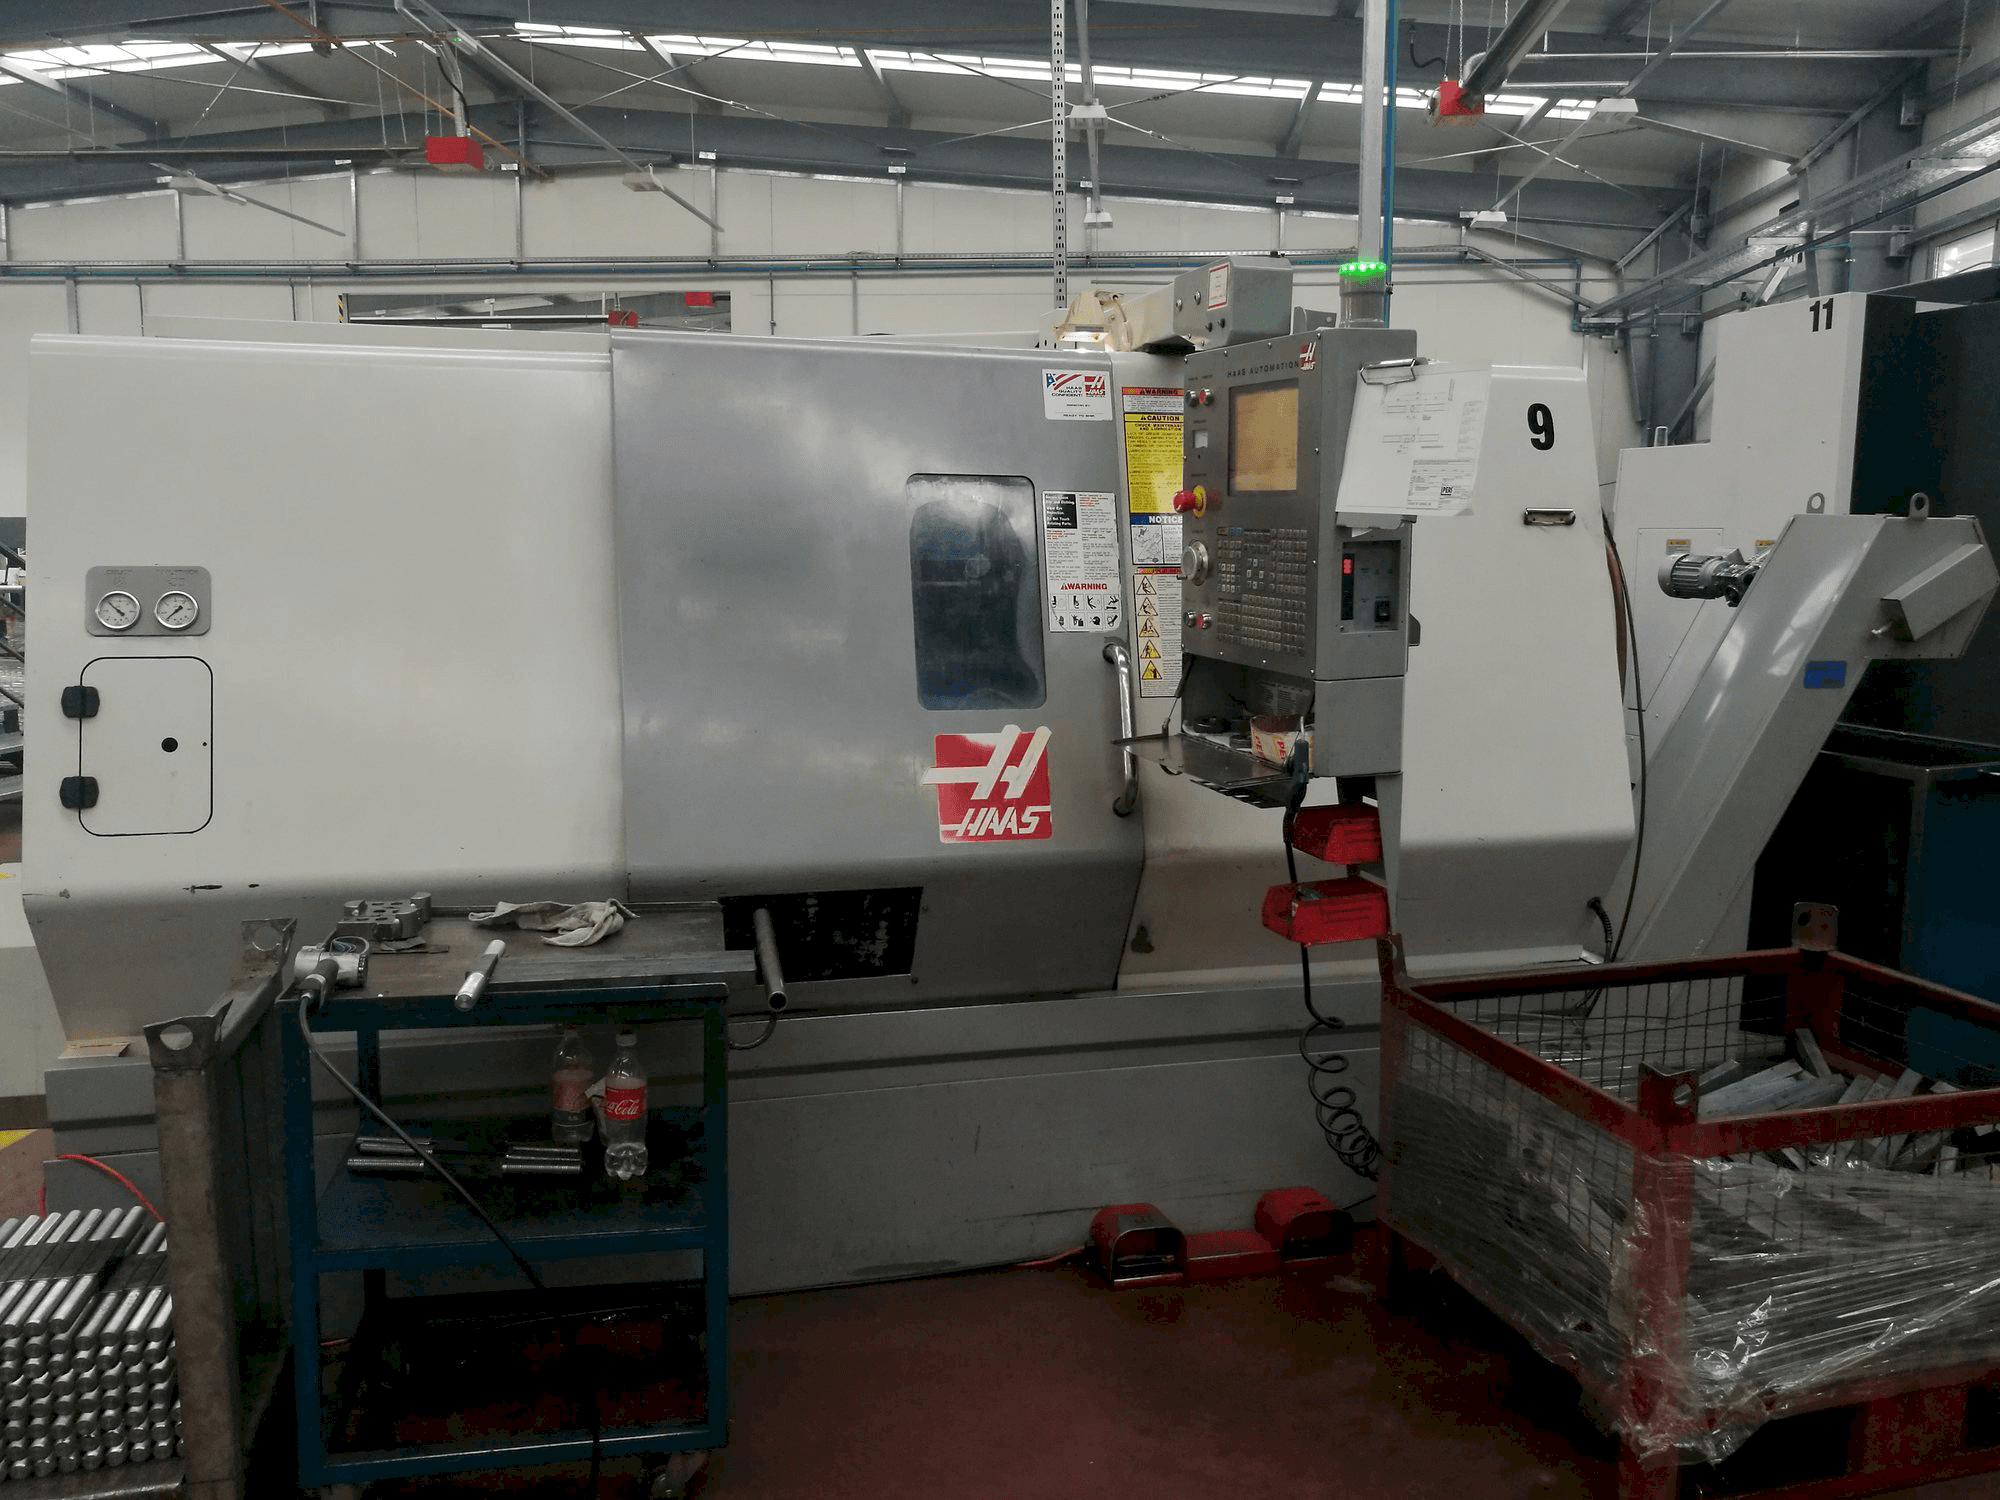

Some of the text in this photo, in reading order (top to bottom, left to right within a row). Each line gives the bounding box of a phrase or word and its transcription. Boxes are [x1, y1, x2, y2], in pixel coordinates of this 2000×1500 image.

[1809, 297, 1834, 333] 11
[1527, 402, 1555, 451] 9
[1148, 515, 1183, 524] NOTICE
[940, 805, 1051, 837] HAAS
